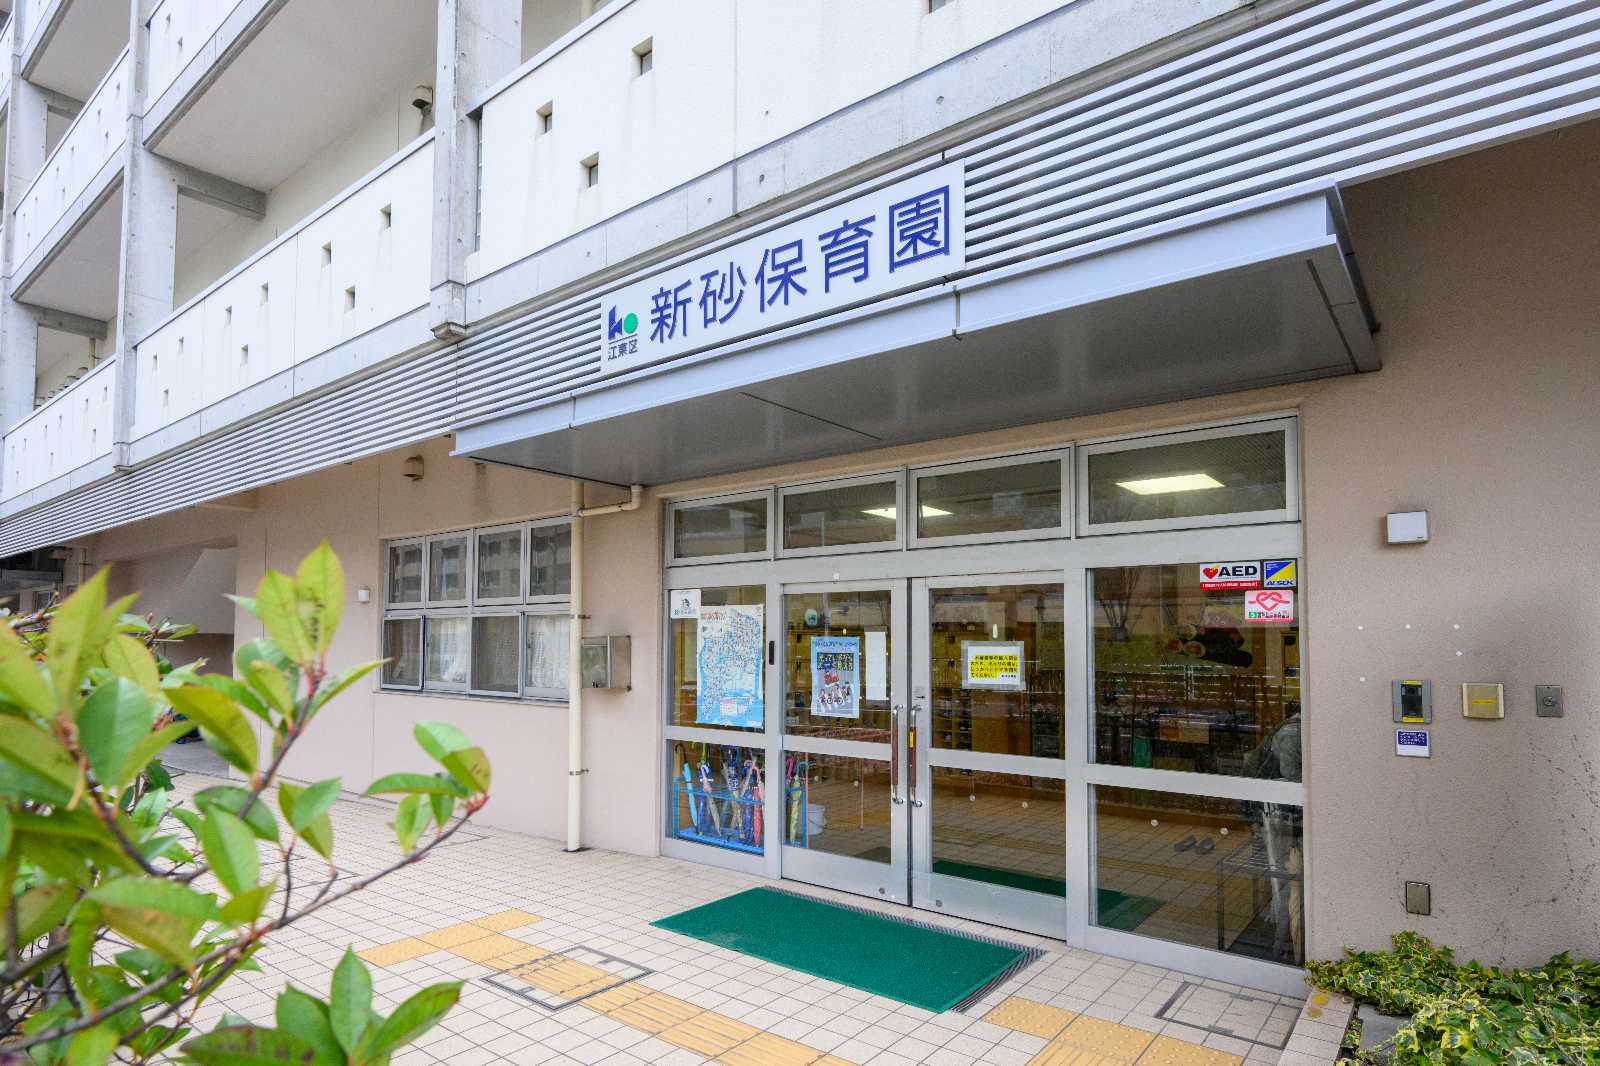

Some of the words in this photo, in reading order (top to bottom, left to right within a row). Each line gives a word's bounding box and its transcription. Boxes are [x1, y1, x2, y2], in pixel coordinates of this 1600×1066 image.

[649, 184, 950, 344] 新砂保育園
[608, 339, 638, 361] 江東区
[1219, 566, 1257, 576] AED
